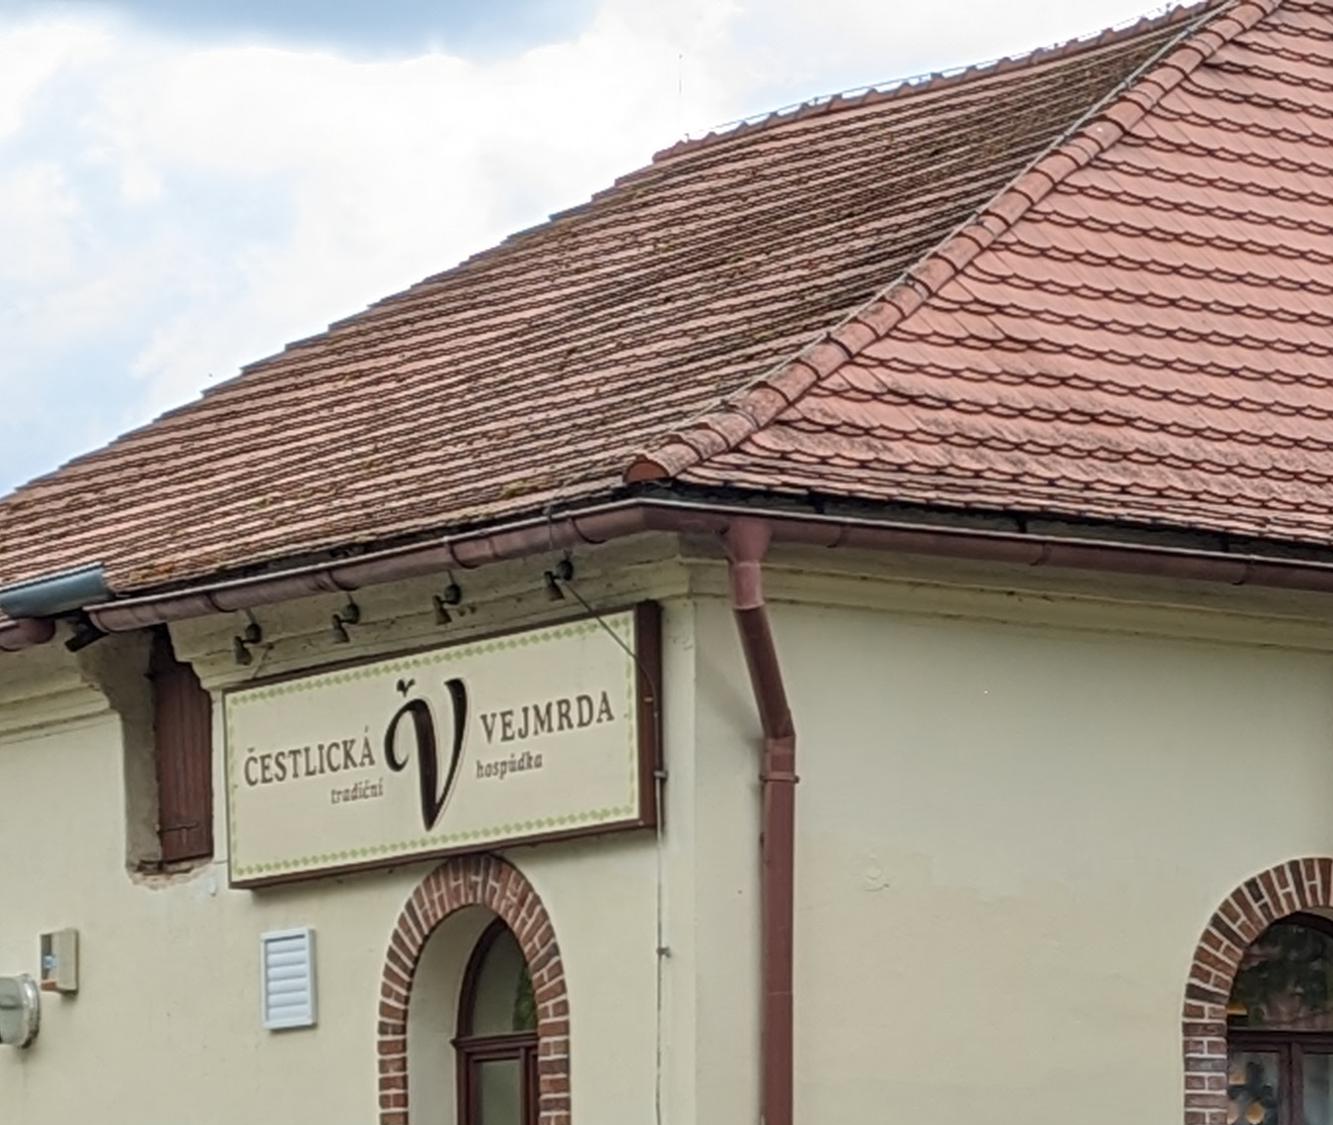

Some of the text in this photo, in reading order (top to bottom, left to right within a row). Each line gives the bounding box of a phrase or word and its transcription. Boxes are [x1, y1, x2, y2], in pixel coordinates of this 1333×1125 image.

[244, 727, 376, 786] ČESTLICKÁ
[480, 691, 614, 744] VEJMRDA
[330, 777, 384, 804] tradiční
